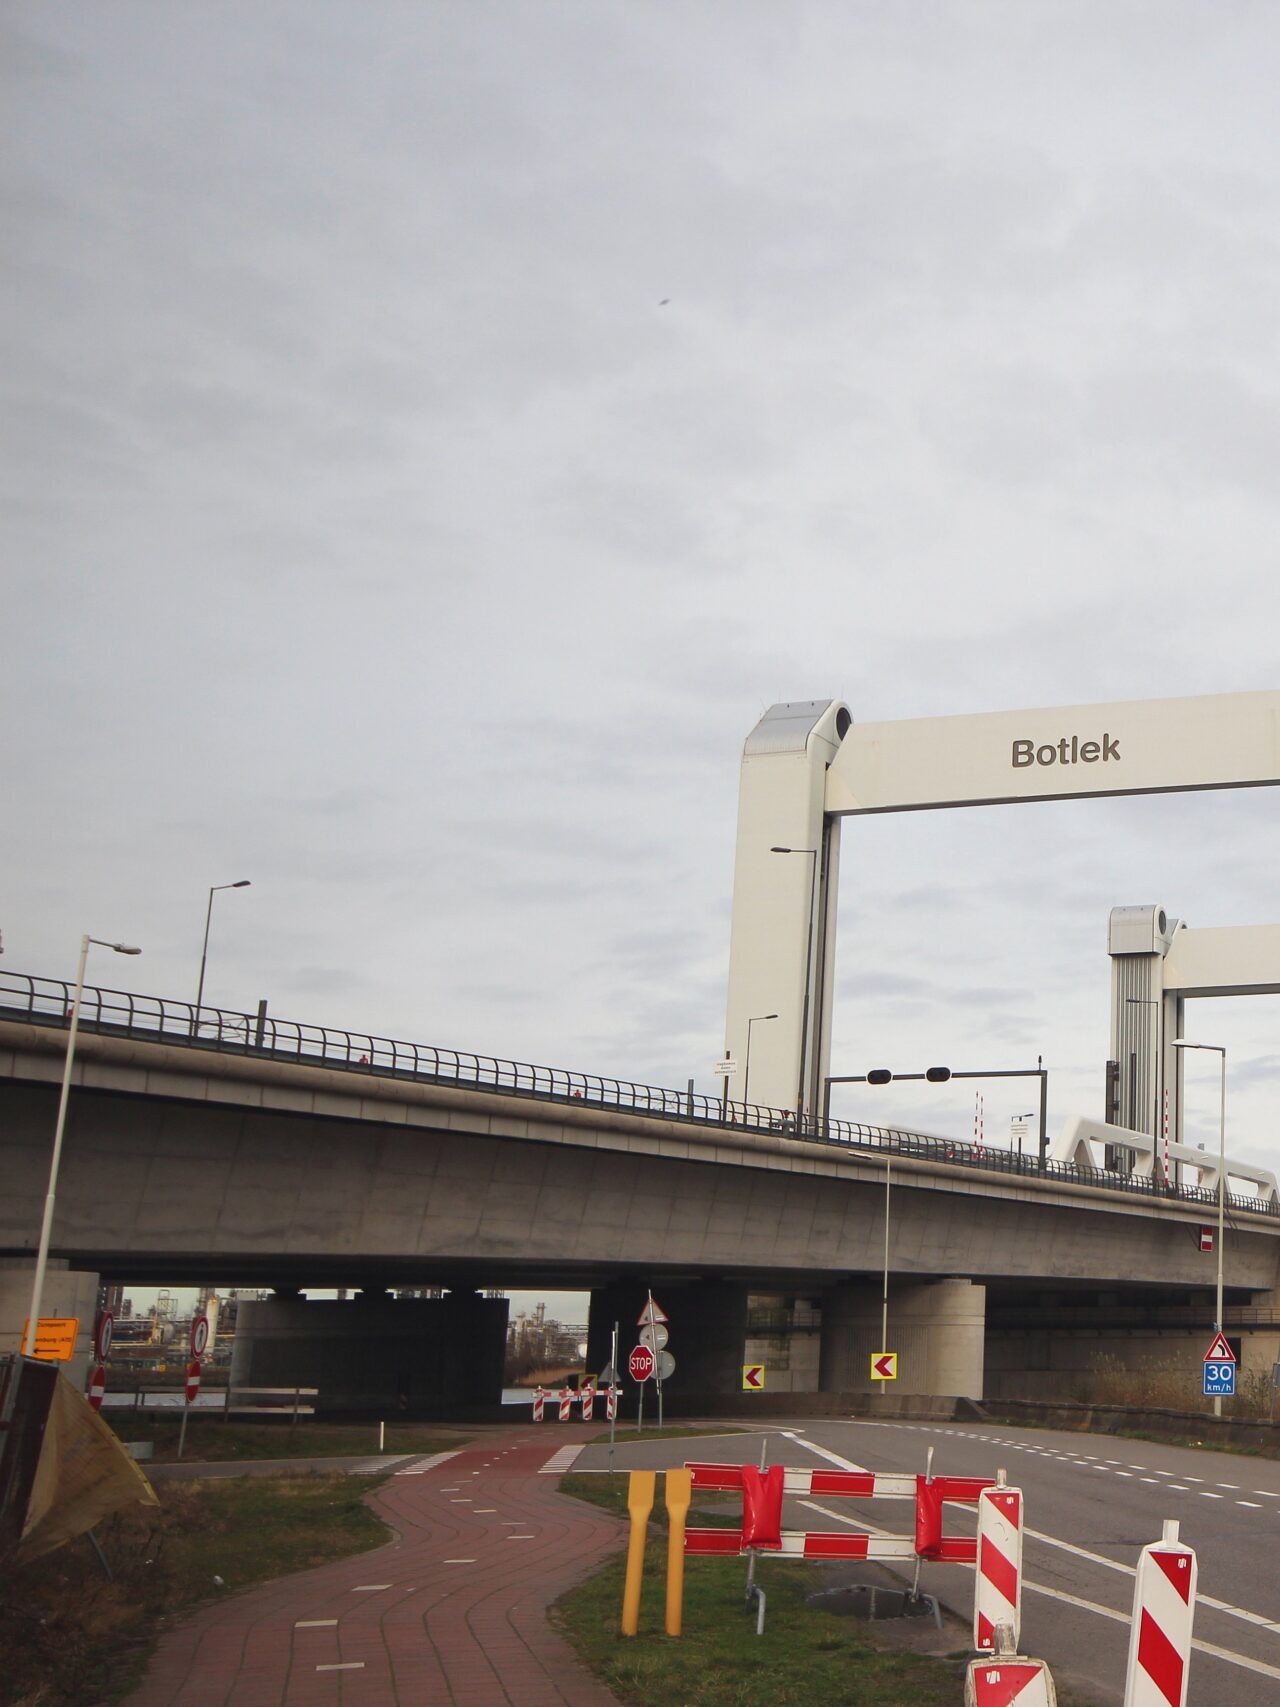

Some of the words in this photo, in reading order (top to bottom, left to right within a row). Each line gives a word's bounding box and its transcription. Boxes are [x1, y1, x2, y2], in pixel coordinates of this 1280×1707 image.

[1012, 733, 1121, 768] Botlek
[630, 1357, 652, 1370] STOP
[1207, 1365, 1232, 1381] 30
[1207, 1383, 1232, 1392] km/h
